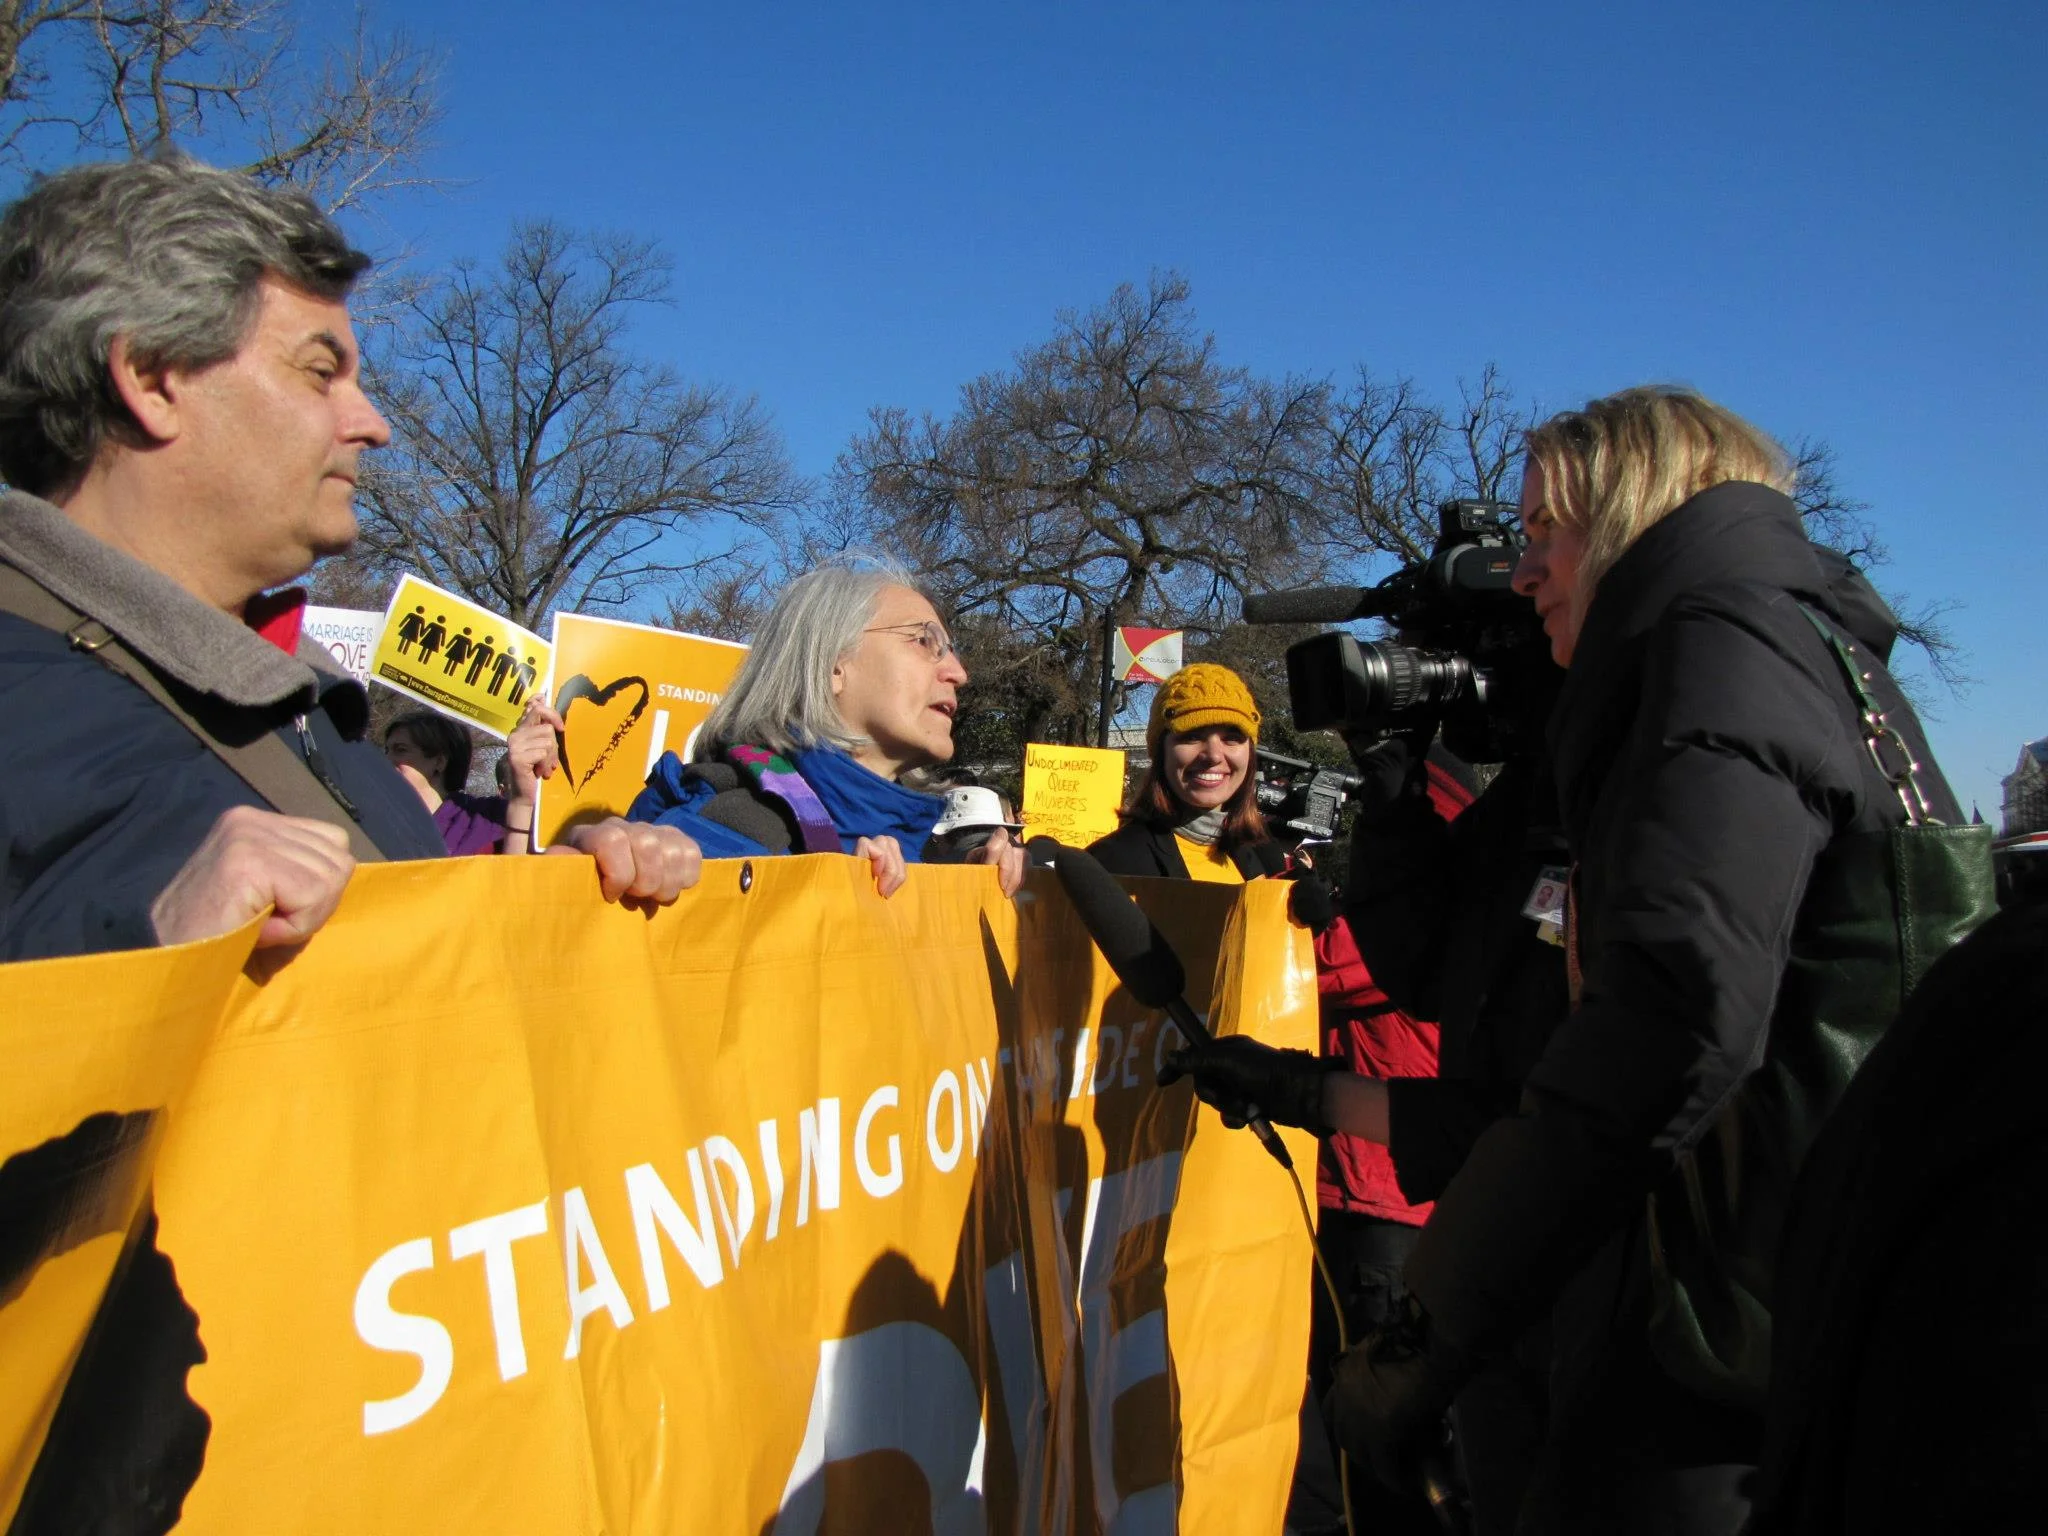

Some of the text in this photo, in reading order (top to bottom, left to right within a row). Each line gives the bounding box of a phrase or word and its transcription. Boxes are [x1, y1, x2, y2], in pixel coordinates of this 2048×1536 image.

[324, 642, 367, 669] OVE
[657, 683, 723, 706] STANDIN
[353, 1084, 904, 1437] STANDING
[925, 1056, 992, 1174] ON
